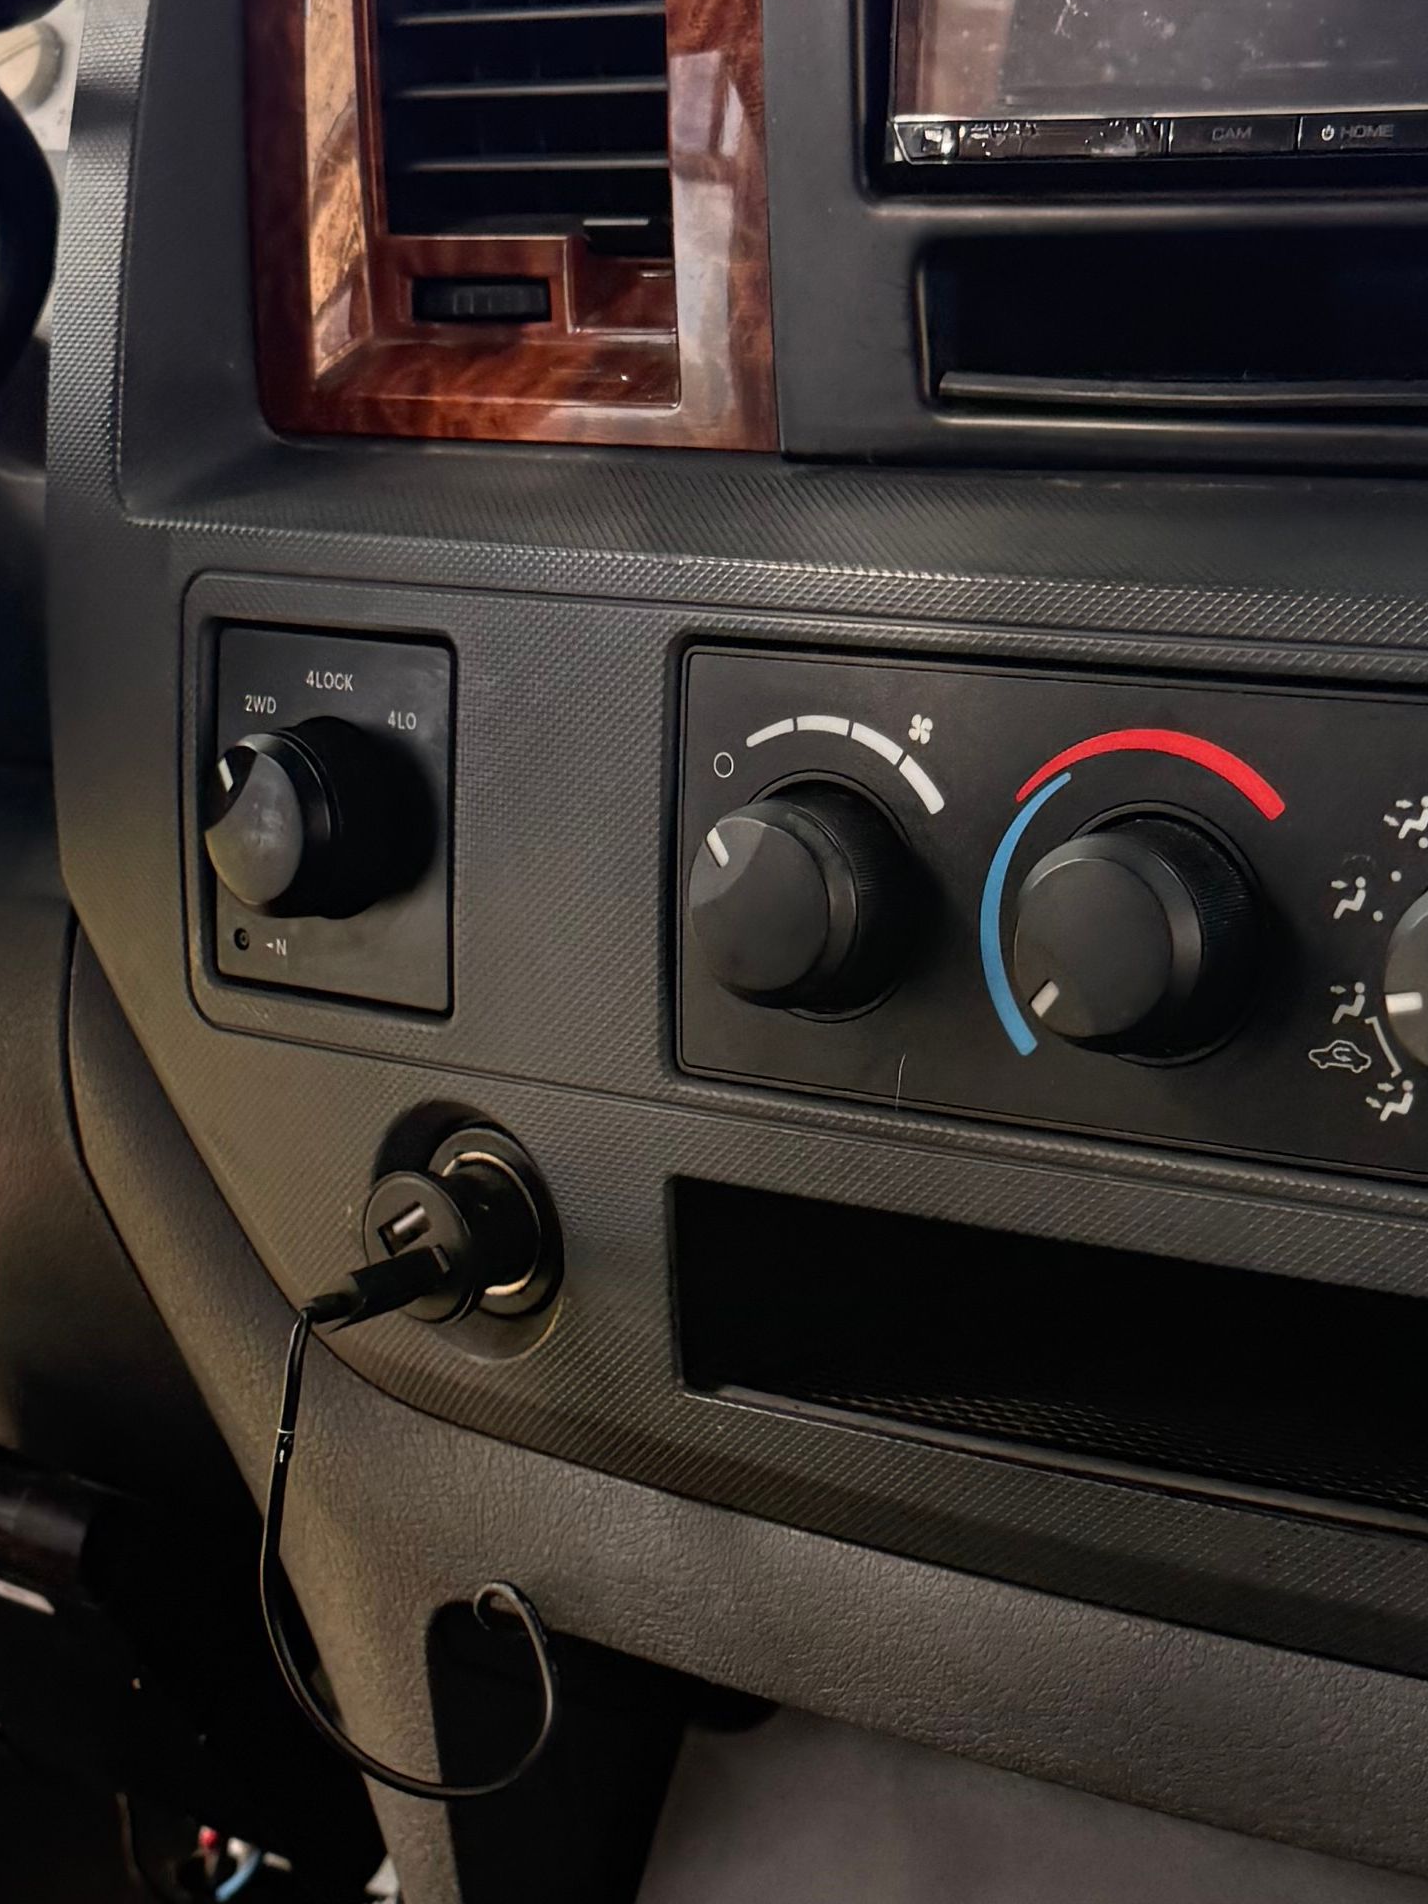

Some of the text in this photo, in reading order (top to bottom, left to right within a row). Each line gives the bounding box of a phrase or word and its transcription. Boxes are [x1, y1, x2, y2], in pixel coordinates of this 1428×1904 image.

[1211, 126, 1253, 143] CAM
[1339, 124, 1395, 140] HOME
[305, 669, 354, 693] 4LOCK
[243, 693, 278, 716] 2WD
[387, 709, 418, 731] 4LO
[275, 938, 288, 956] N
